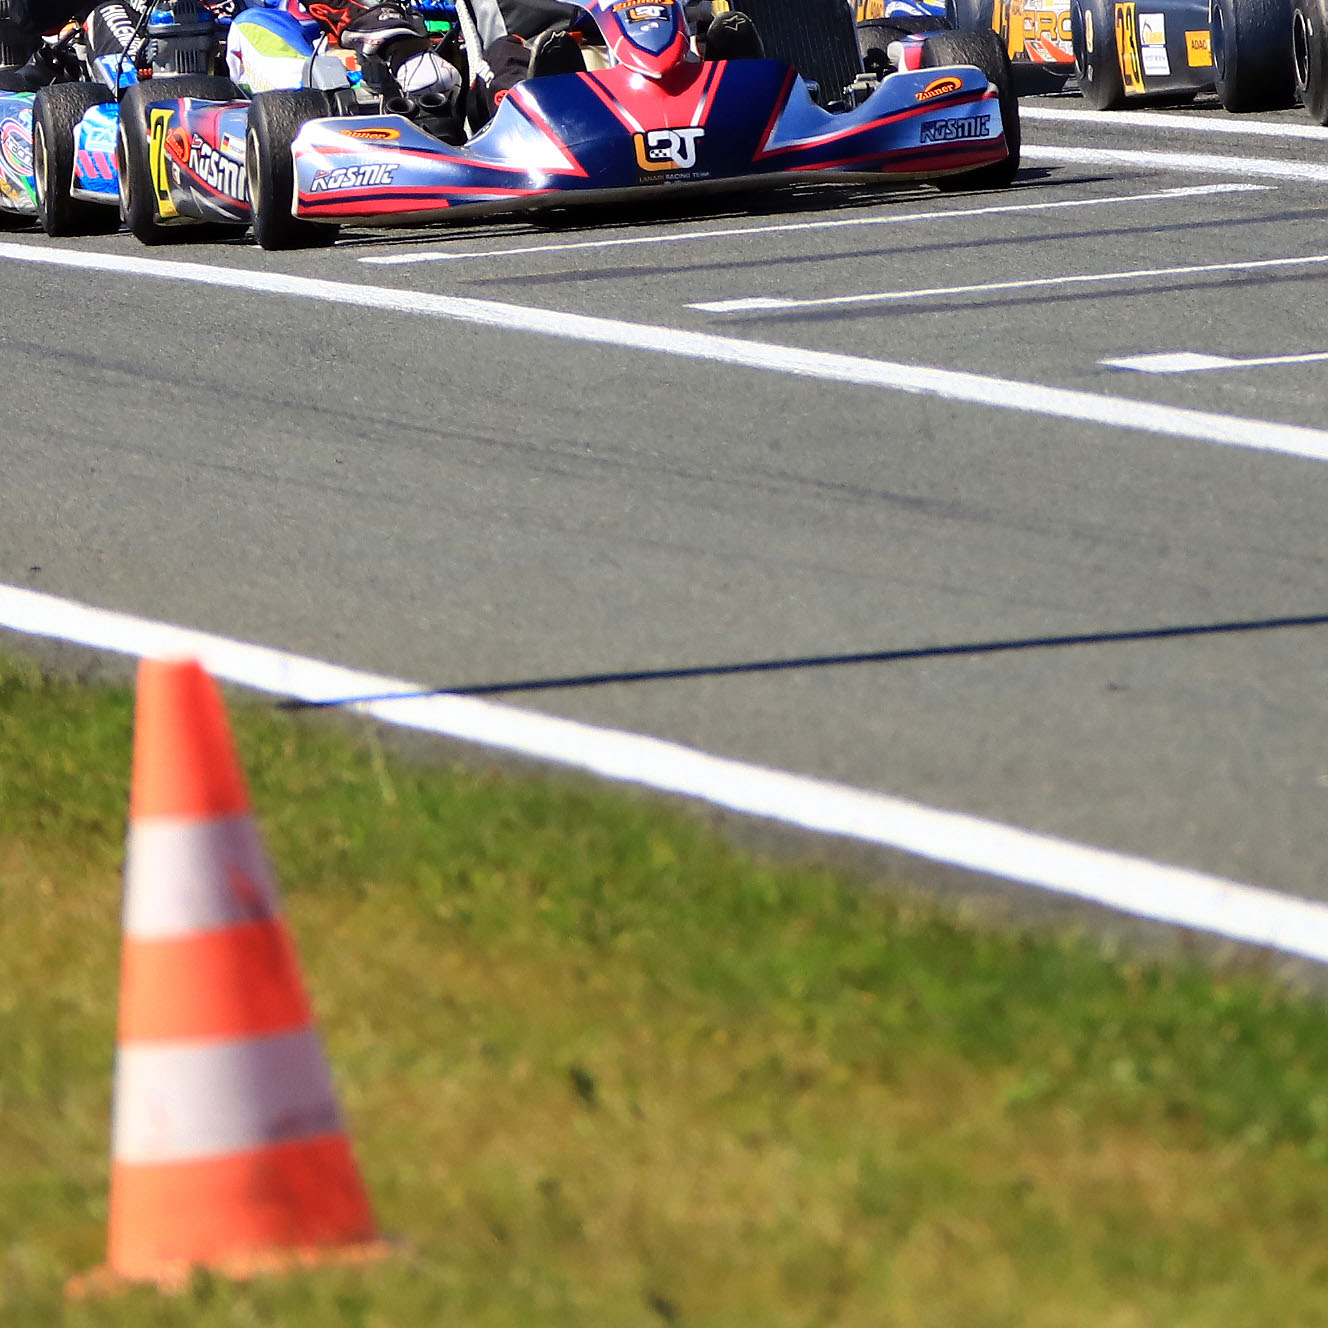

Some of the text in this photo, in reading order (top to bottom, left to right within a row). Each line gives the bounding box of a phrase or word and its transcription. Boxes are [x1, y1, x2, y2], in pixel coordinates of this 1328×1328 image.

[915, 84, 954, 101] Zinner
[919, 114, 991, 144] KOSMIC
[310, 163, 400, 192] KOSMIC
[665, 172, 691, 181] RACING
